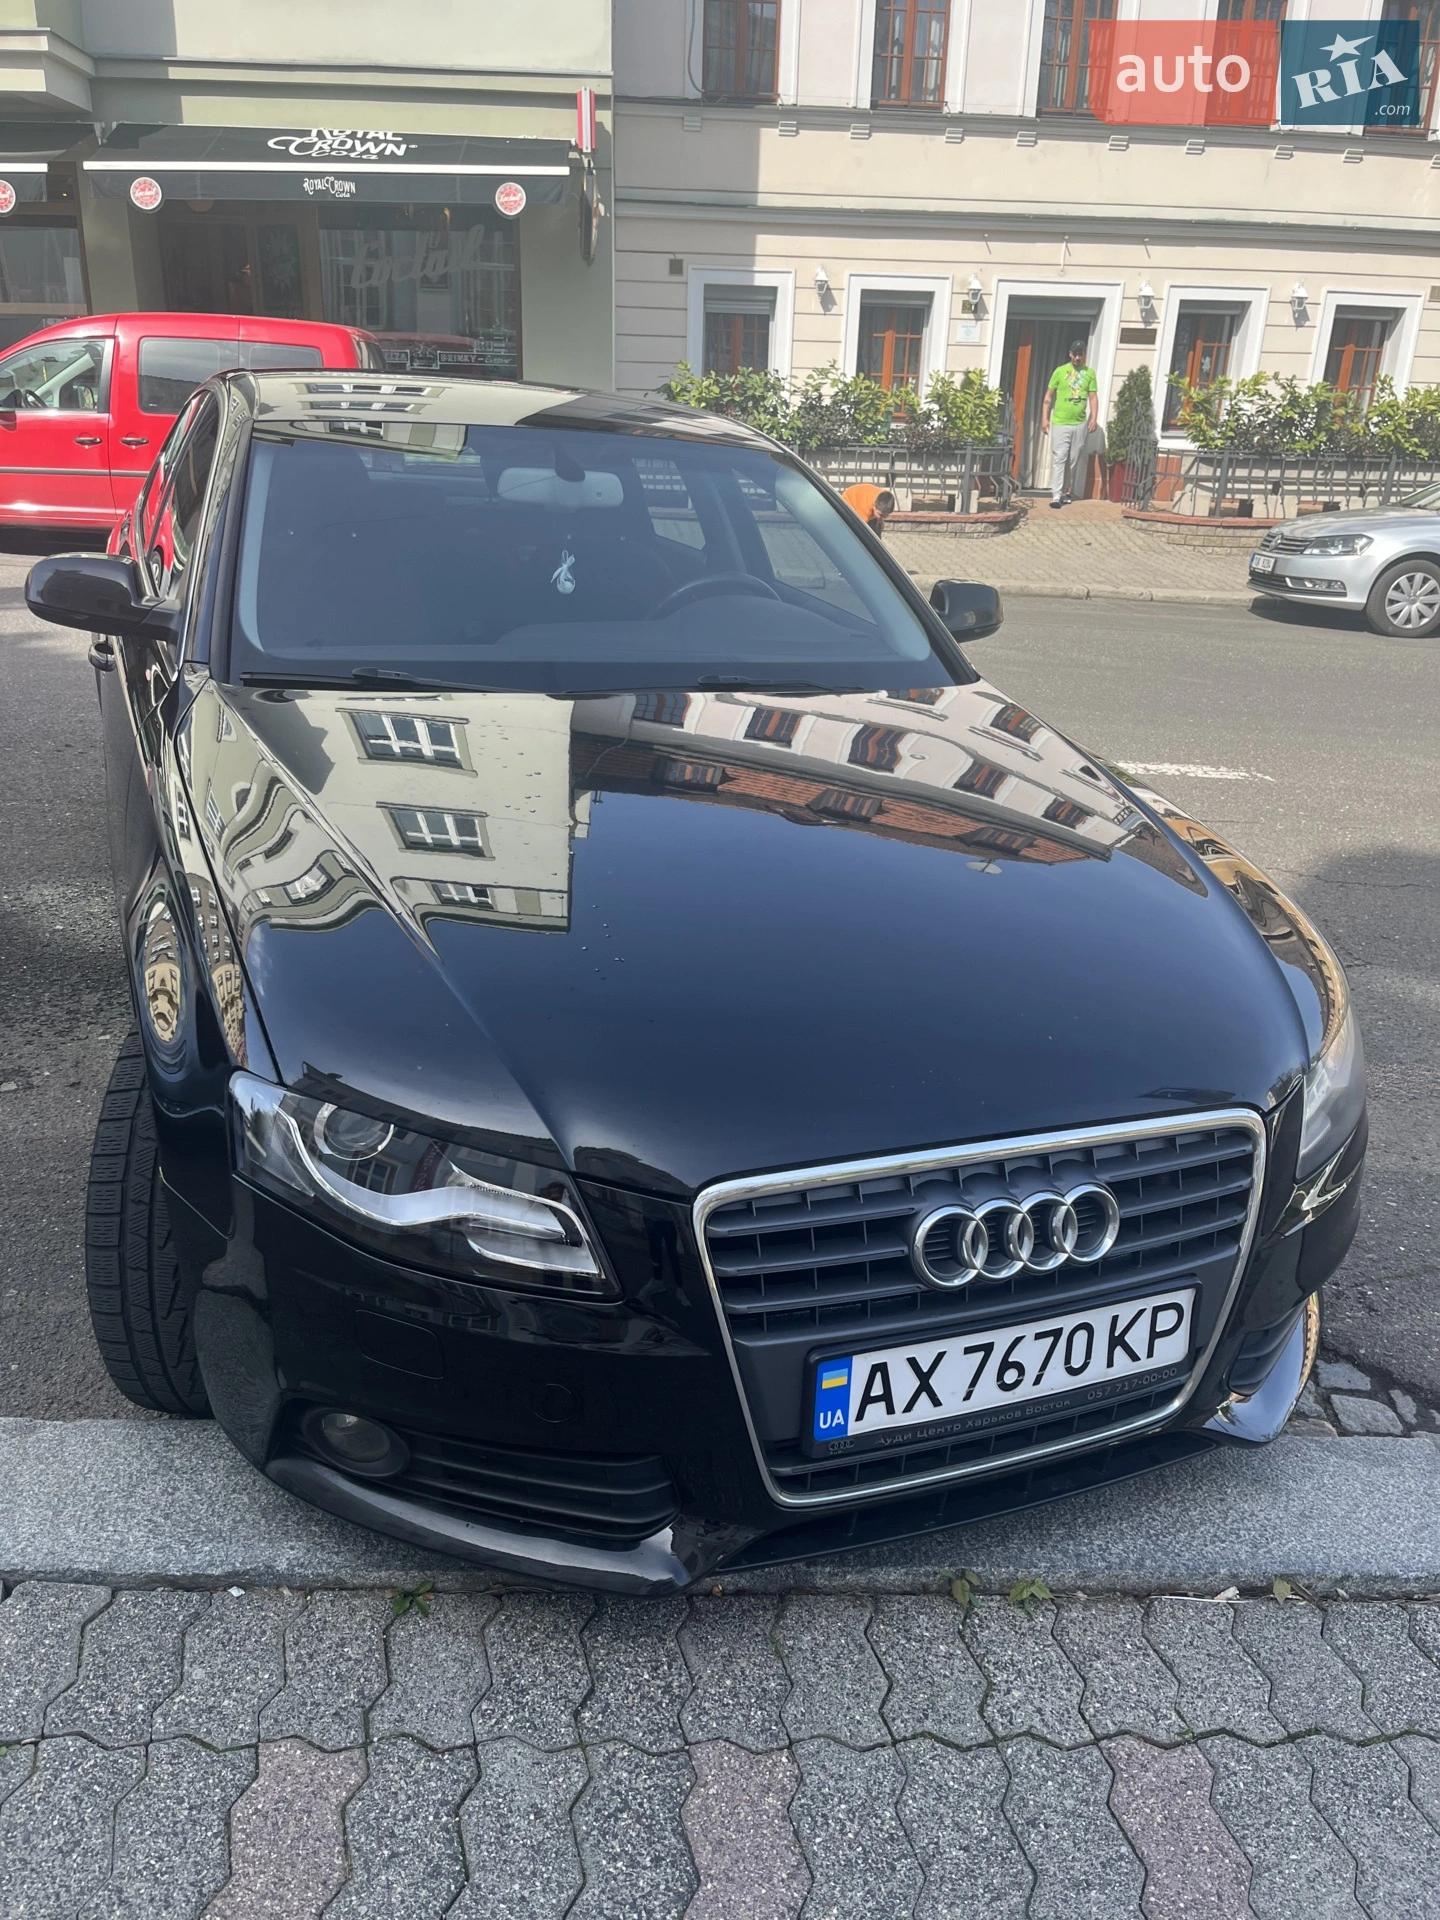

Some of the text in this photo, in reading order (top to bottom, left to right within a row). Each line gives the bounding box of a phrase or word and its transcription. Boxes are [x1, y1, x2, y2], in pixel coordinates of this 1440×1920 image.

[267, 136, 408, 157] CROWN
[854, 1302, 1185, 1422] AX 7670 KP
[819, 1409, 845, 1429] UA
[875, 1367, 1178, 1446] Ауди Центр Харьков Восток 057 717-00-00
